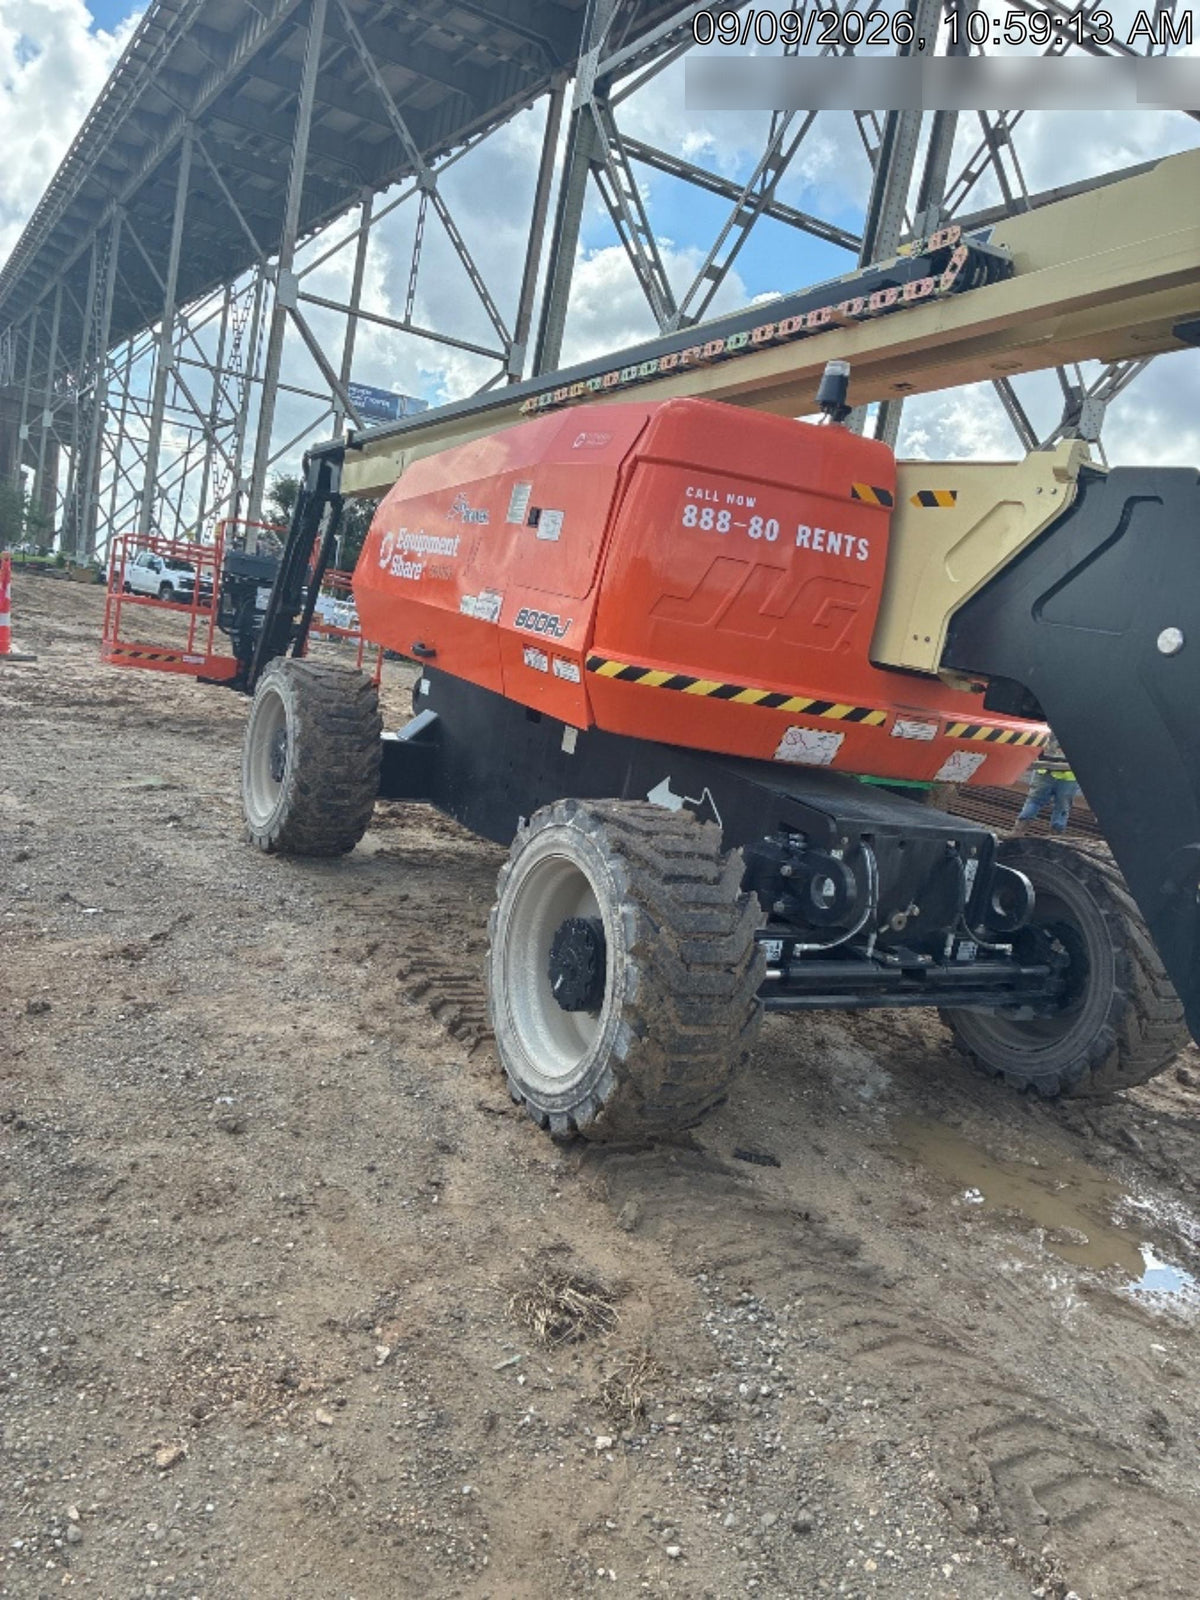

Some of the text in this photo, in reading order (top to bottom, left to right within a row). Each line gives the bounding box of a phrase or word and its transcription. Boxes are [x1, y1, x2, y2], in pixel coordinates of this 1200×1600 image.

[686, 487, 757, 508] CALL NOW
[396, 527, 461, 558] Equipment
[682, 504, 870, 562] 888-80 RENTS
[389, 554, 423, 581] Share
[649, 556, 872, 652] JLG
[513, 608, 573, 640] 800AJ
